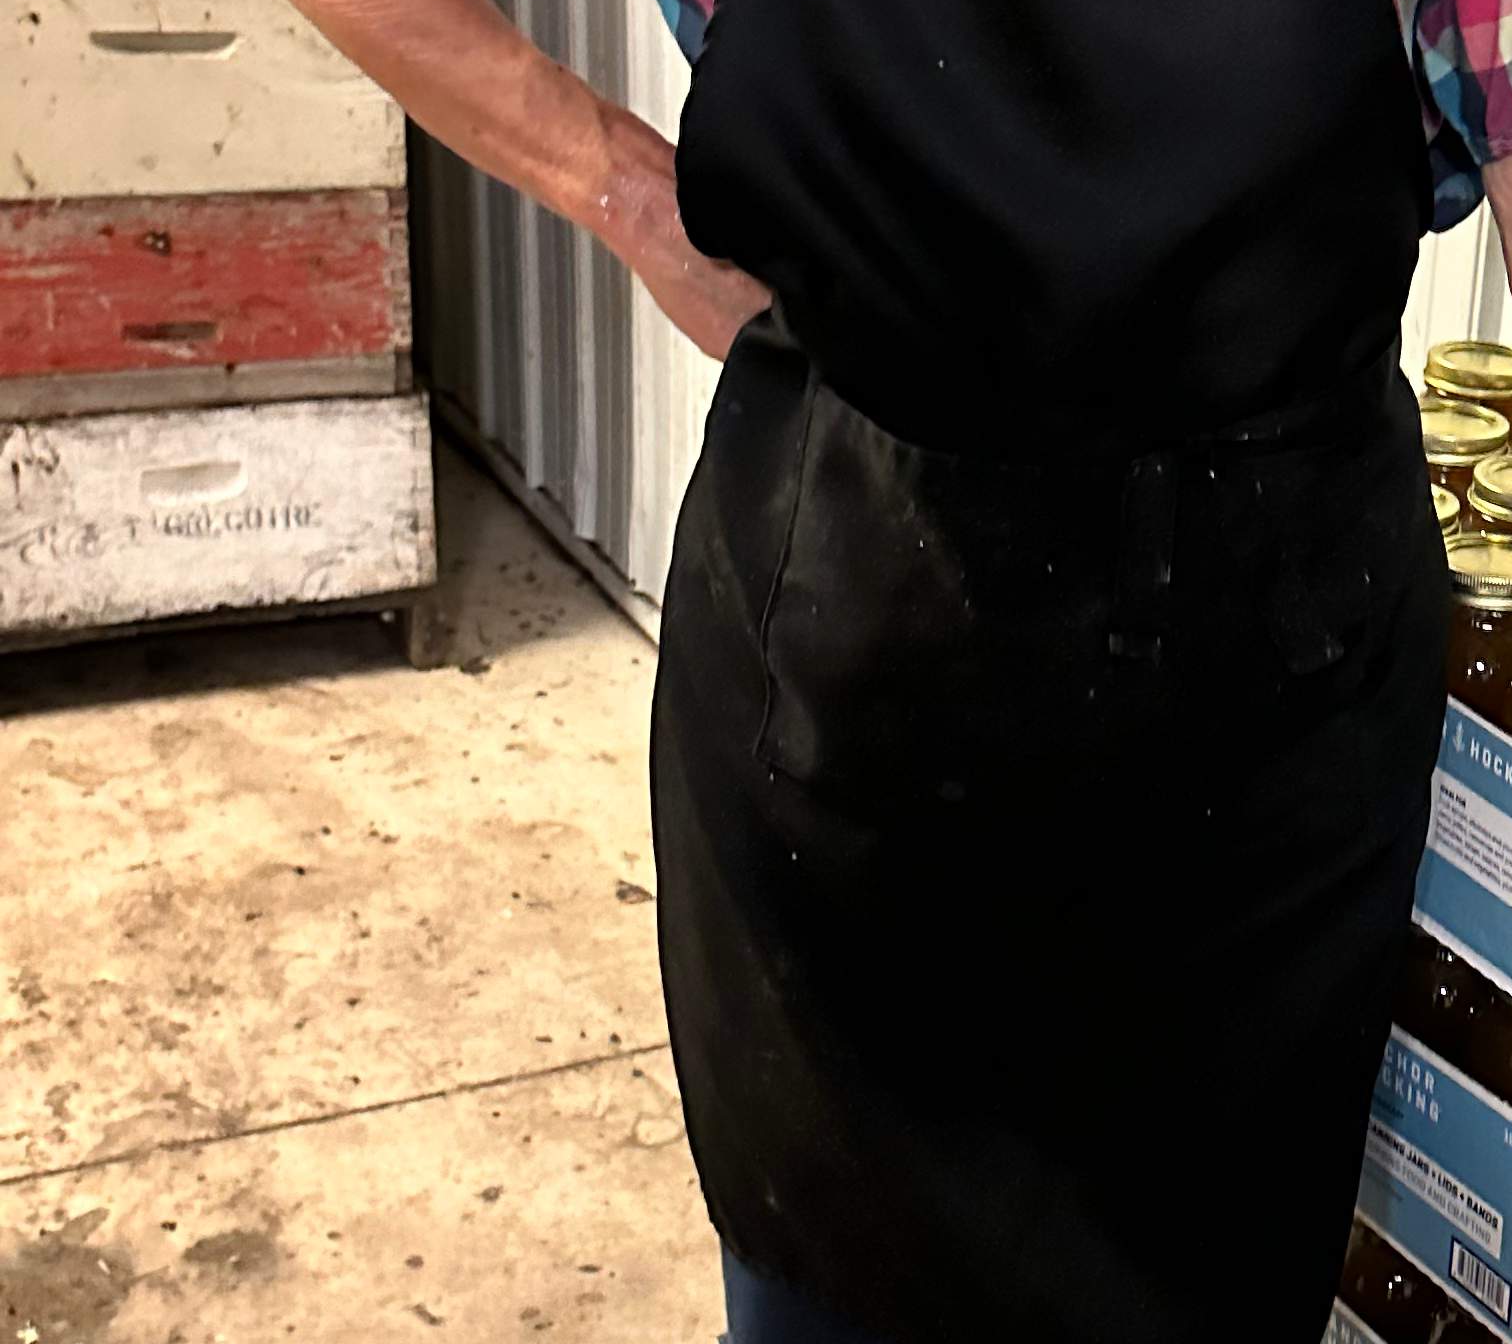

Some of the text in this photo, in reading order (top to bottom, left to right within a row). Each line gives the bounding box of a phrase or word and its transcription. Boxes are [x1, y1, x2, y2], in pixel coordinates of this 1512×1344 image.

[1385, 1044, 1436, 1093] CHOR
[1382, 1065, 1440, 1123] CKING
[1466, 1195, 1499, 1229] BANDS
